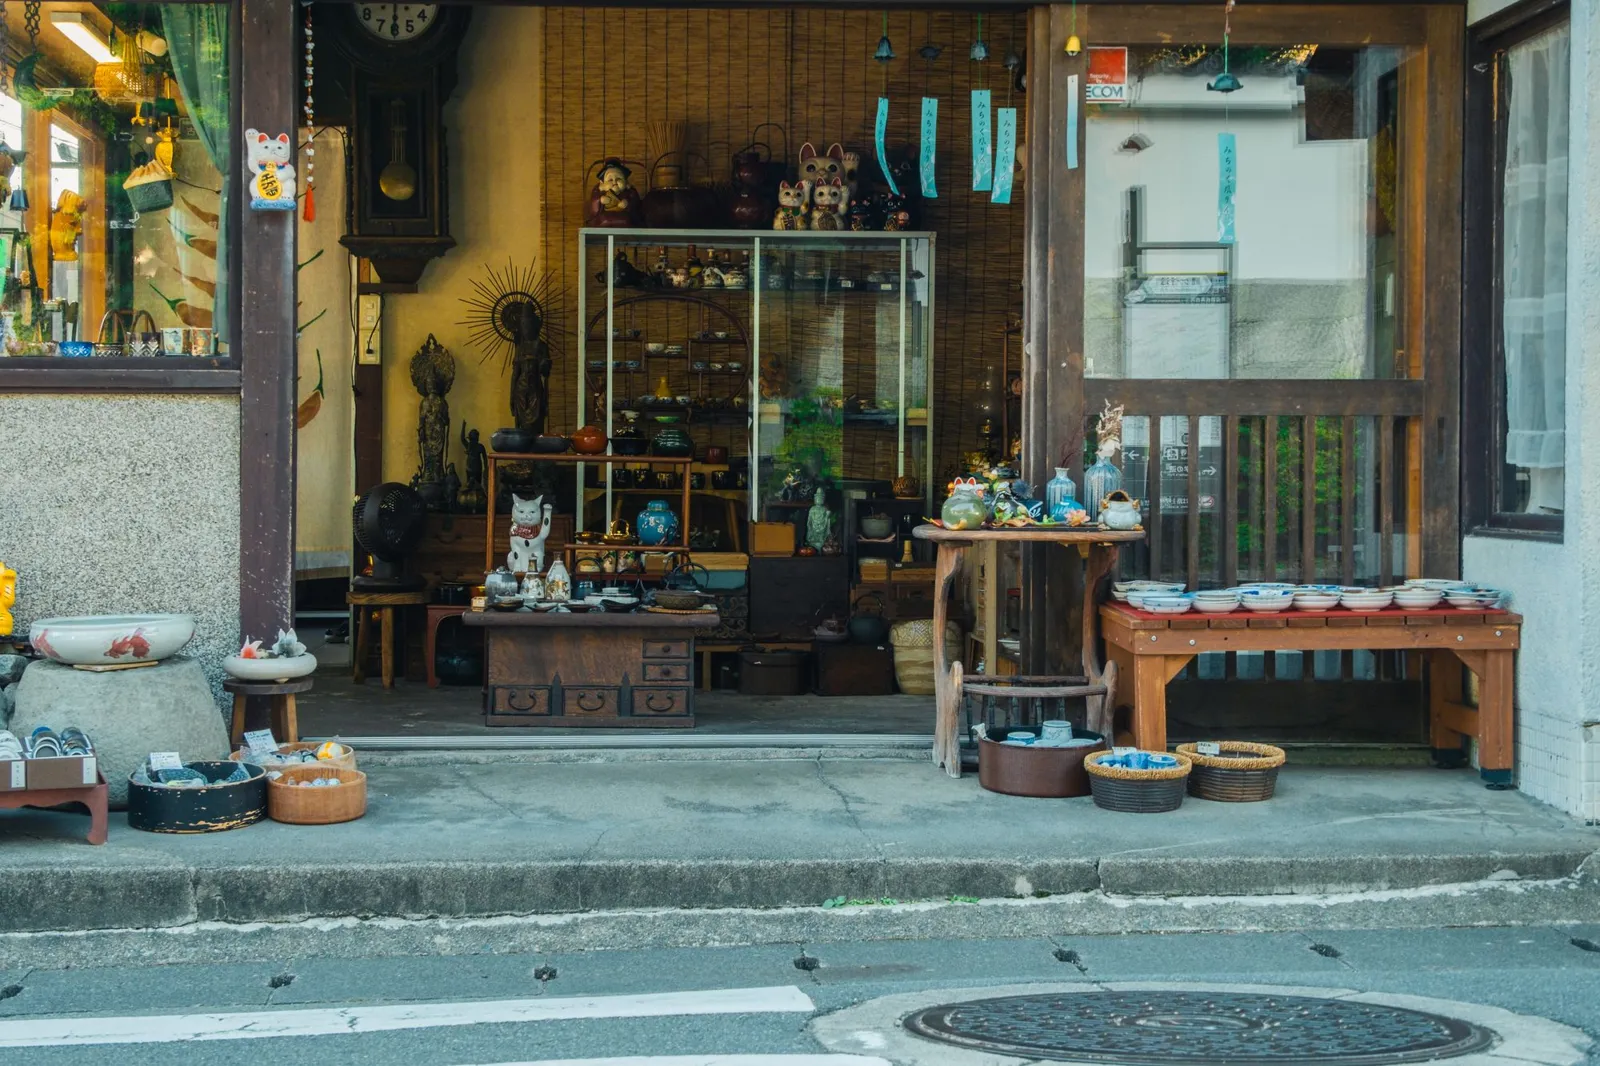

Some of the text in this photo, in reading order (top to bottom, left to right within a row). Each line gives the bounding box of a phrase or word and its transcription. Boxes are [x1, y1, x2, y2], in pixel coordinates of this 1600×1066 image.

[363, 7, 371, 21] 8
[417, 8, 427, 22] 4
[376, 18, 385, 32] 7
[406, 20, 414, 33] 5
